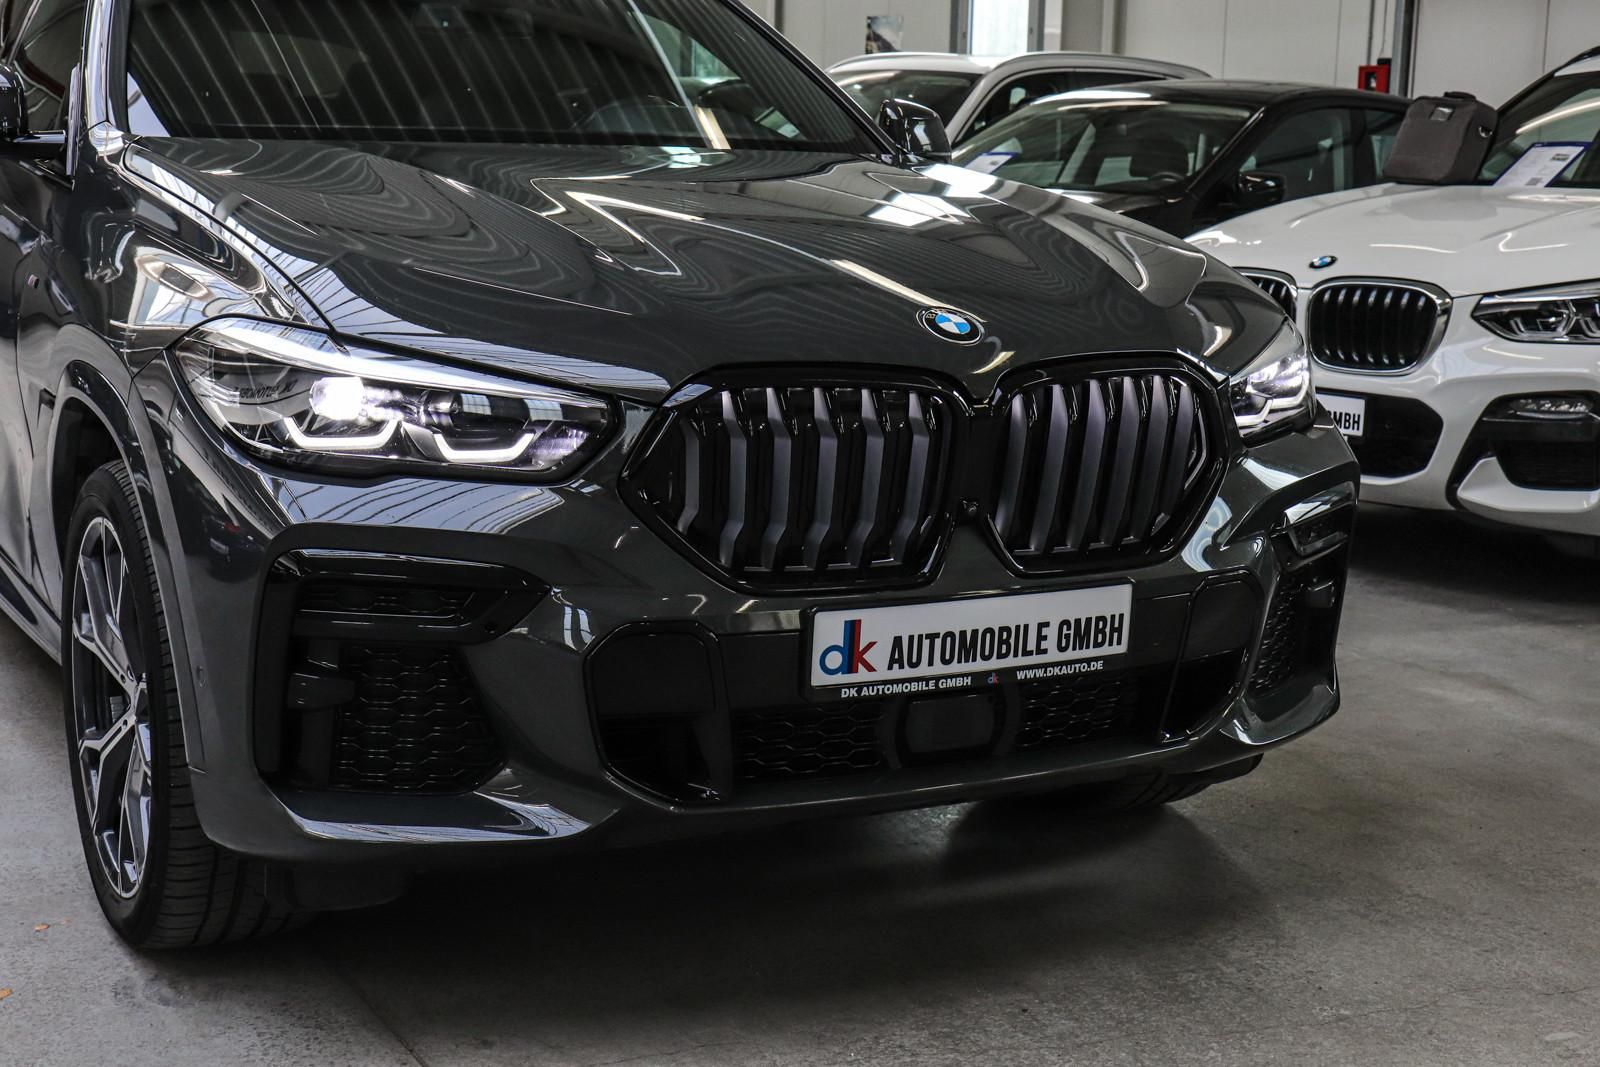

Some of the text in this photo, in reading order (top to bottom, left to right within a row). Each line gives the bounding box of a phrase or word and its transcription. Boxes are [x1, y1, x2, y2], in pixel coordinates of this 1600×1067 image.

[819, 612, 1125, 676] dk AUTOMOBILE GMBH
[987, 672, 999, 684] dk
[1016, 660, 1104, 680] WWW.DKAUTO.DE
[841, 676, 972, 698] DK AUTOMOBILE GMBH
